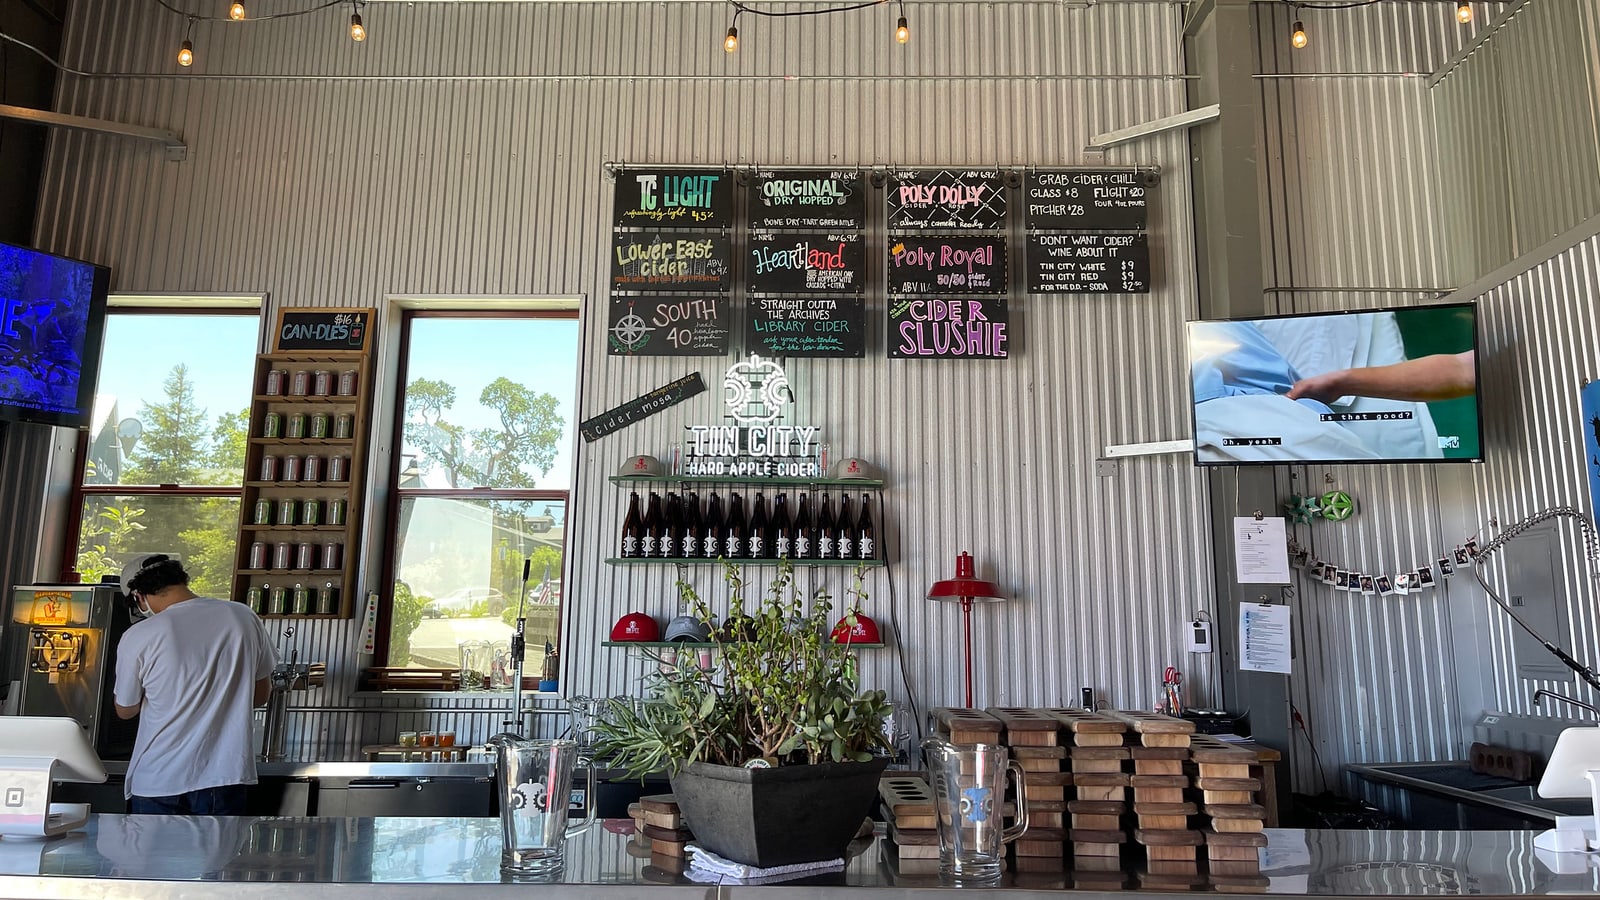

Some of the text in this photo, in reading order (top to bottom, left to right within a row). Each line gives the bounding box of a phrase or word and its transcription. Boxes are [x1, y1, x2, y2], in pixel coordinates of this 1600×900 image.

[830, 171, 842, 179] ABV
[1038, 174, 1070, 185] GRAB
[1073, 173, 1103, 184] CIDER
[1110, 173, 1136, 184] CHILL
[636, 174, 719, 210] TC LIGHT
[763, 179, 844, 197] ORIGINAL
[1030, 187, 1079, 198] GLASS $8
[1094, 186, 1144, 198] FLIGHT $20
[774, 196, 834, 205] DRY HOPPED
[899, 184, 986, 207] POLY DOLLY
[1030, 204, 1085, 216] PITCHER $28
[763, 218, 783, 226] BONE
[819, 218, 838, 227] GREEN
[1040, 235, 1134, 246] DONT WANT CIDER?
[616, 239, 713, 266] Lower East
[1048, 247, 1118, 257] WINE ABOUT IT
[706, 259, 723, 268] ABV
[895, 245, 993, 273] Poly Royal
[641, 258, 688, 276] cider
[1040, 260, 1135, 271] TIN CITY WHITE $9
[937, 273, 966, 288] 50/50
[1080, 273, 1099, 281] RED
[1121, 271, 1135, 281] $9
[902, 281, 918, 293] ABV
[1089, 282, 1109, 291] SODA
[760, 300, 837, 310] STRAIGHT OUTTA
[909, 299, 988, 321] CIDER
[653, 299, 717, 327] SOUTH
[767, 310, 830, 320] THE ARCHIVES
[334, 313, 352, 326] $16
[282, 323, 348, 340] CAN-DLES
[754, 319, 849, 333] LIBRARY CIDER
[666, 327, 692, 348] 40
[899, 320, 1007, 357] SLUSHIE
[1341, 413, 1368, 421] that
[1376, 412, 1411, 421] good?
[691, 426, 815, 457] TIN CITY
[689, 462, 816, 477] HARD APPLE CIDER
